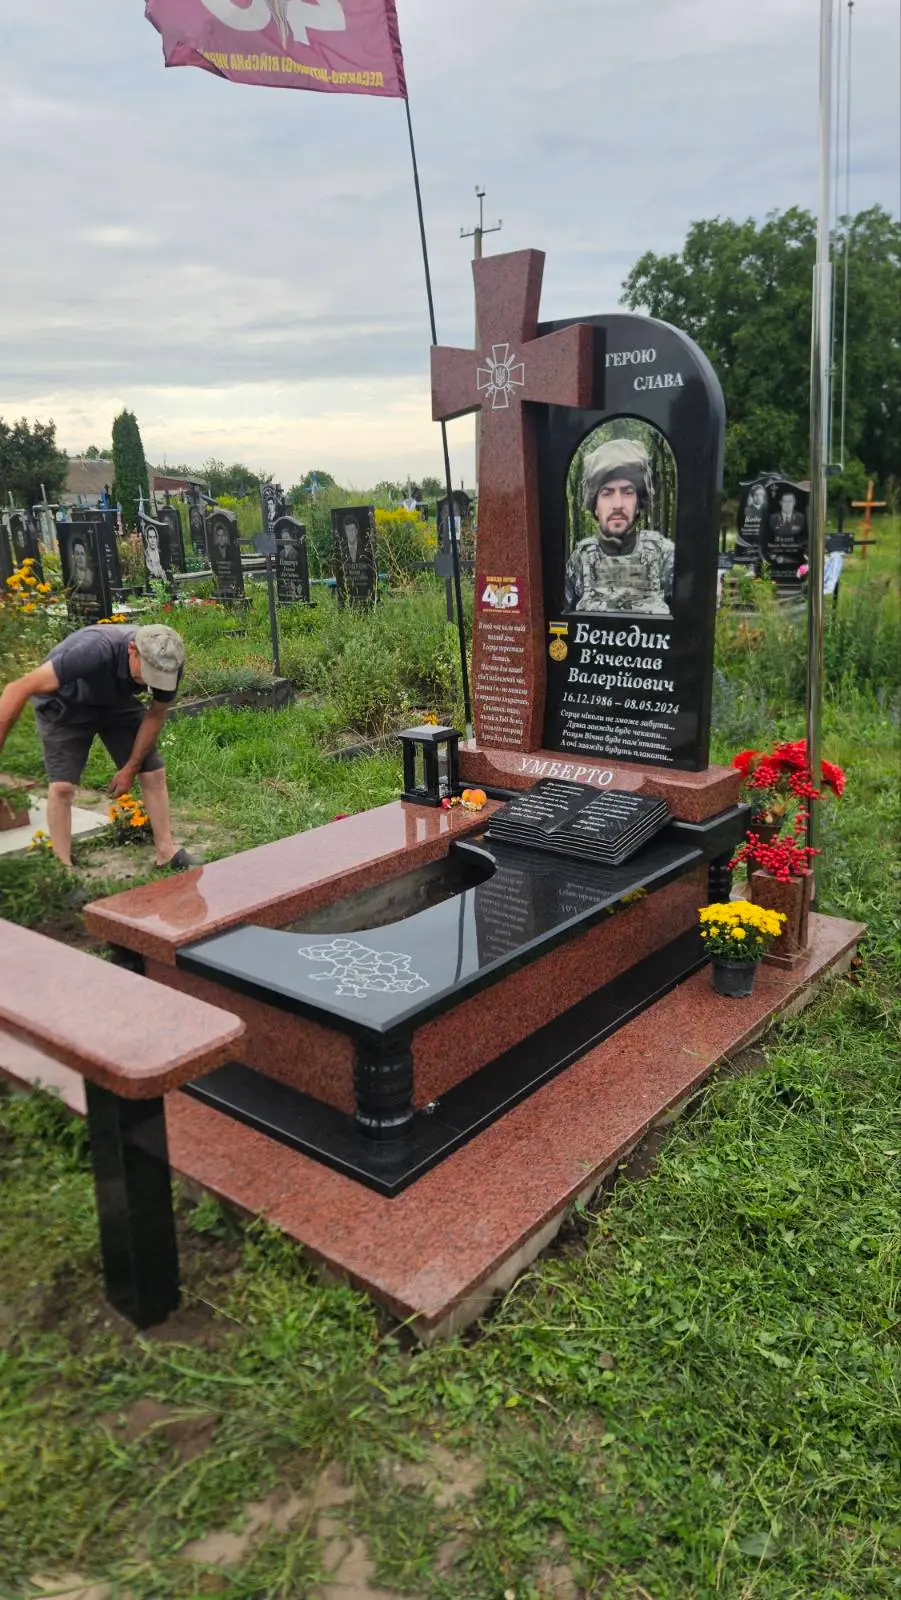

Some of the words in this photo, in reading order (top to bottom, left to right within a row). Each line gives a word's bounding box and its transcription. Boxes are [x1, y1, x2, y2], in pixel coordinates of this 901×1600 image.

[605, 348, 656, 368] ГЕРОЮ
[633, 372, 684, 390] СЛАВА
[574, 623, 671, 650] Бенедик
[568, 667, 675, 693] Валерійович
[562, 692, 613, 707] 16.12.1986
[624, 698, 680, 715] 08.05.2024
[560, 709, 580, 720] Серце
[605, 734, 621, 744] буде
[614, 726, 632, 736] буде
[518, 756, 614, 786] УМБЕРТО
